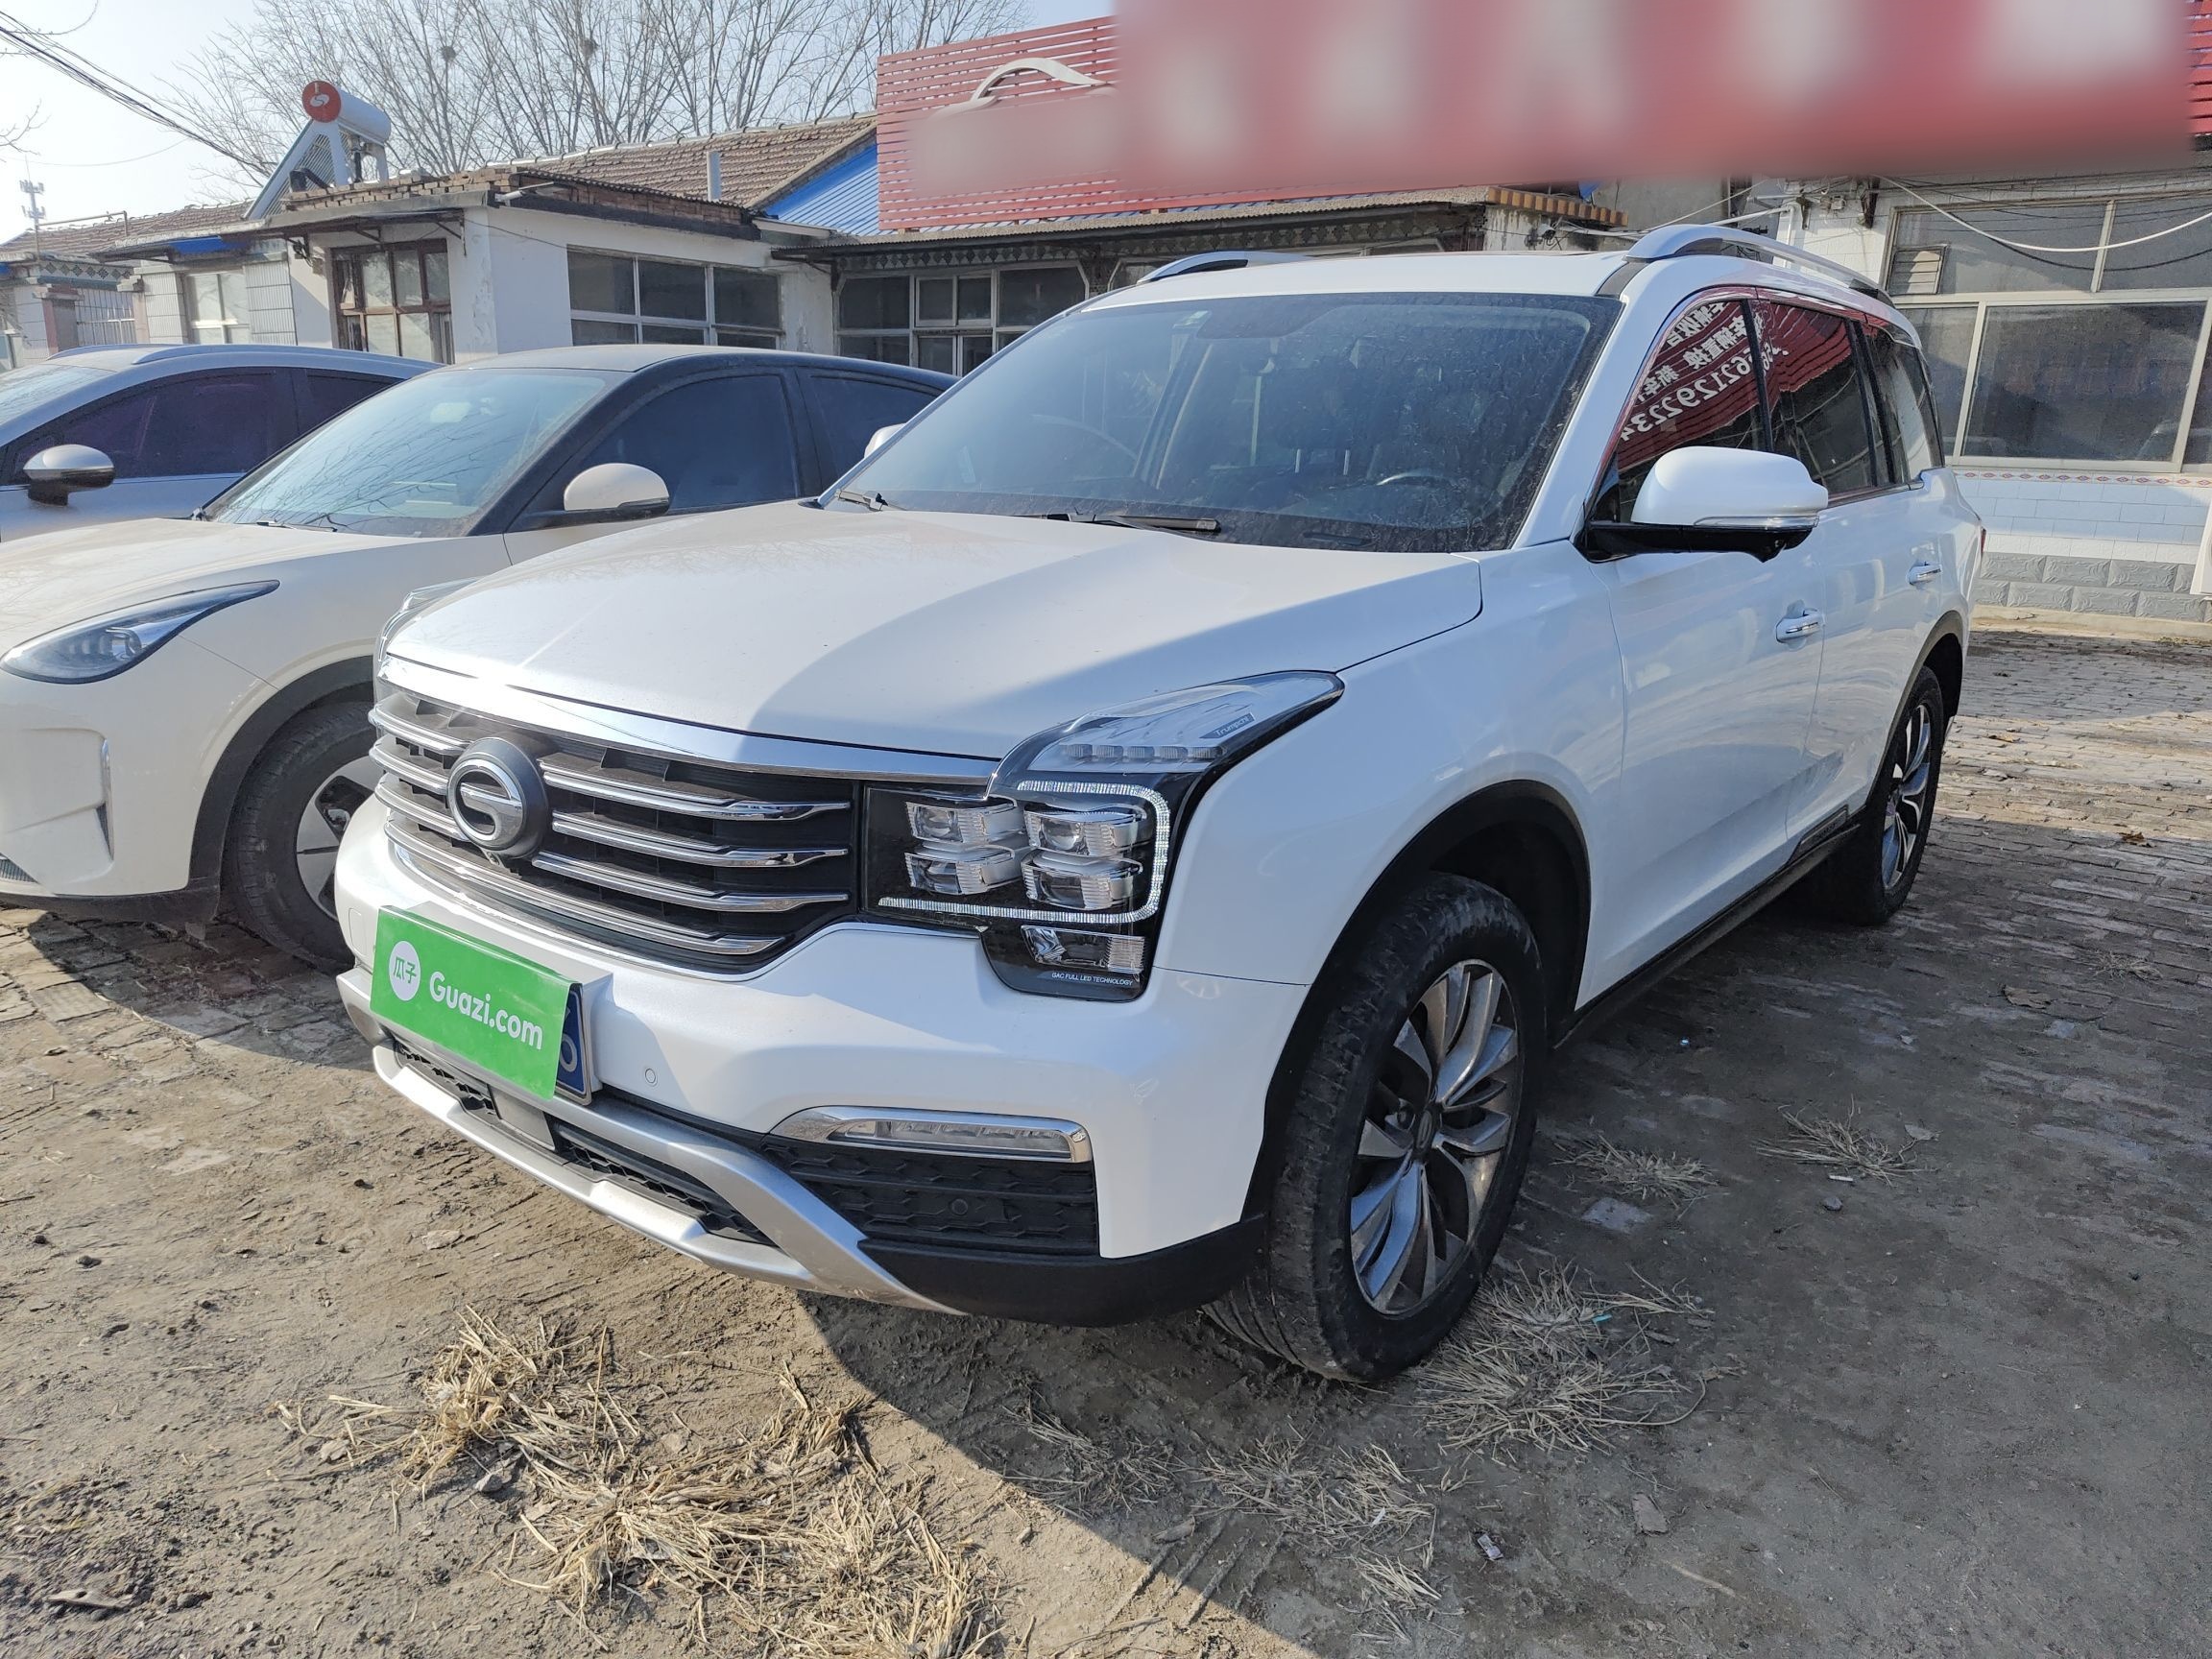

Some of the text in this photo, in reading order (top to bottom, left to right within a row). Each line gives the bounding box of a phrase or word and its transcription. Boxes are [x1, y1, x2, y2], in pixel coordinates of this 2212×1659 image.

[393, 956, 418, 984] 瓜子
[1093, 975, 1133, 986] TECHNOLOGY
[429, 971, 542, 1050] Guazi.com
